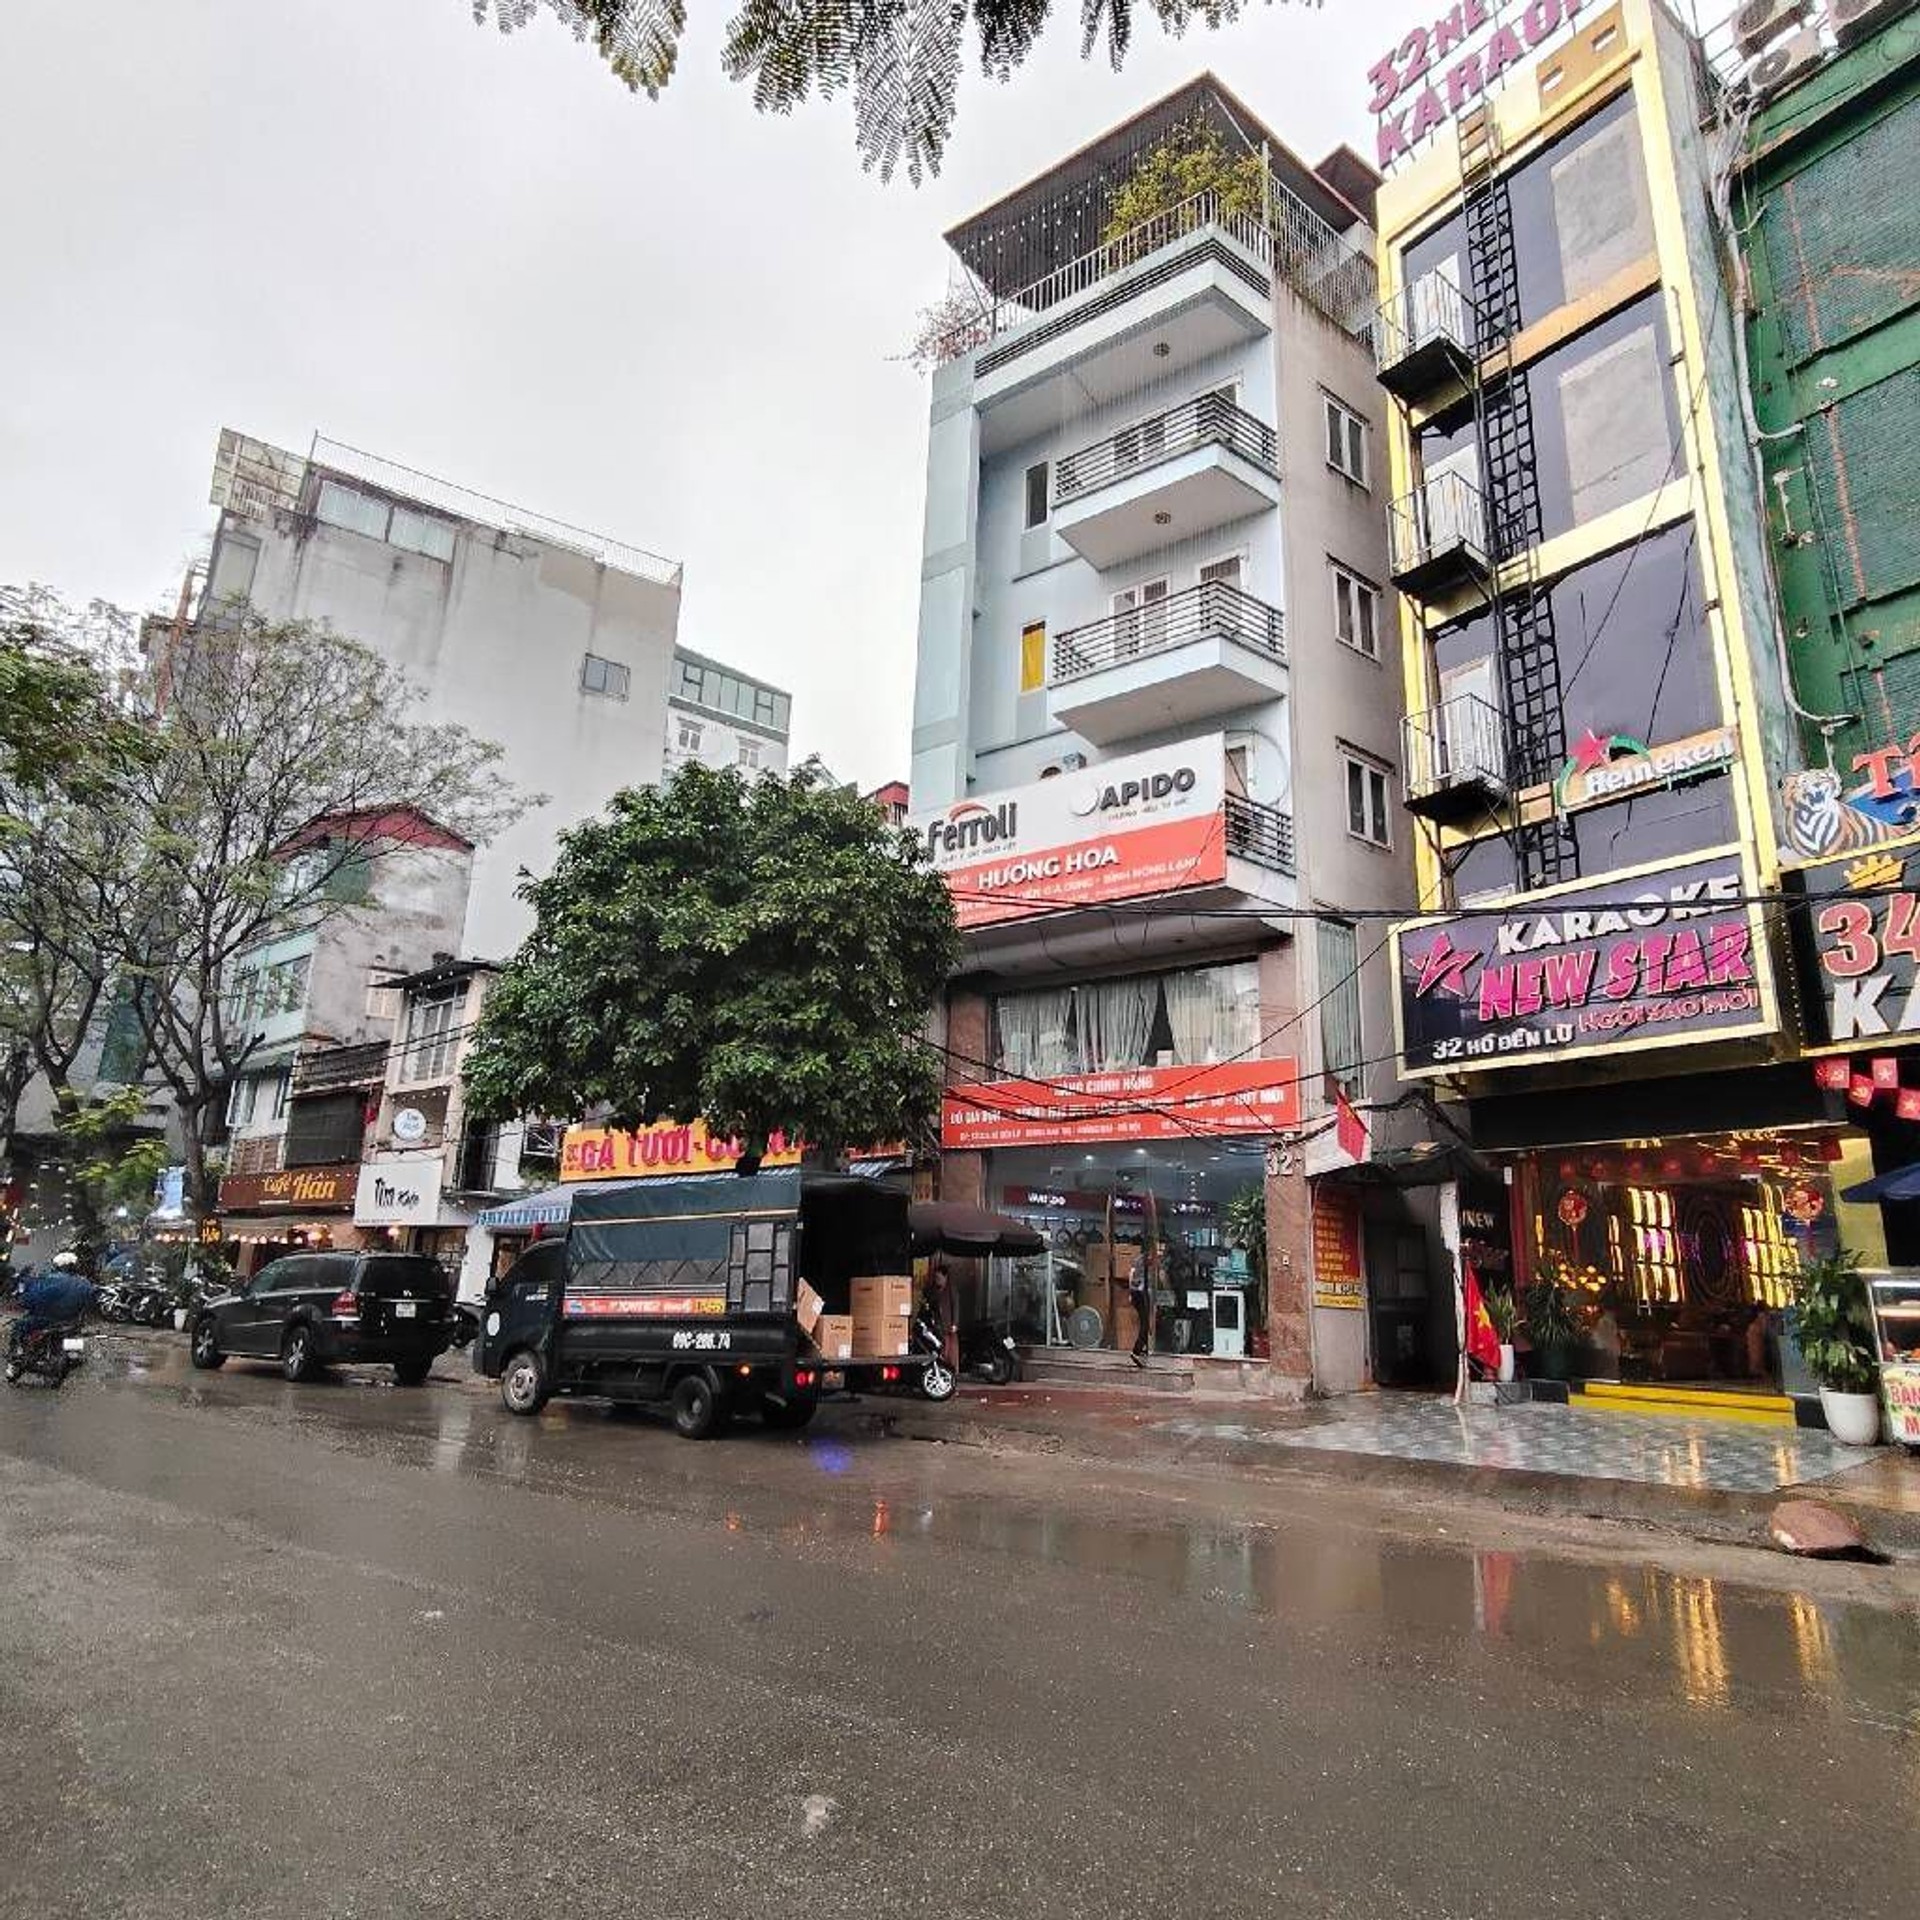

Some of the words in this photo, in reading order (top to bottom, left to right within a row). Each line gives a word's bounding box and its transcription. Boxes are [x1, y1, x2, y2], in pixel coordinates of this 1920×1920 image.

[1376, 0, 1583, 170] KARAO
[1498, 874, 1741, 955] KARAOKE
[1818, 892, 1920, 976] 34
[1479, 949, 1598, 1022] NEW
[1605, 922, 1752, 1000] STAR
